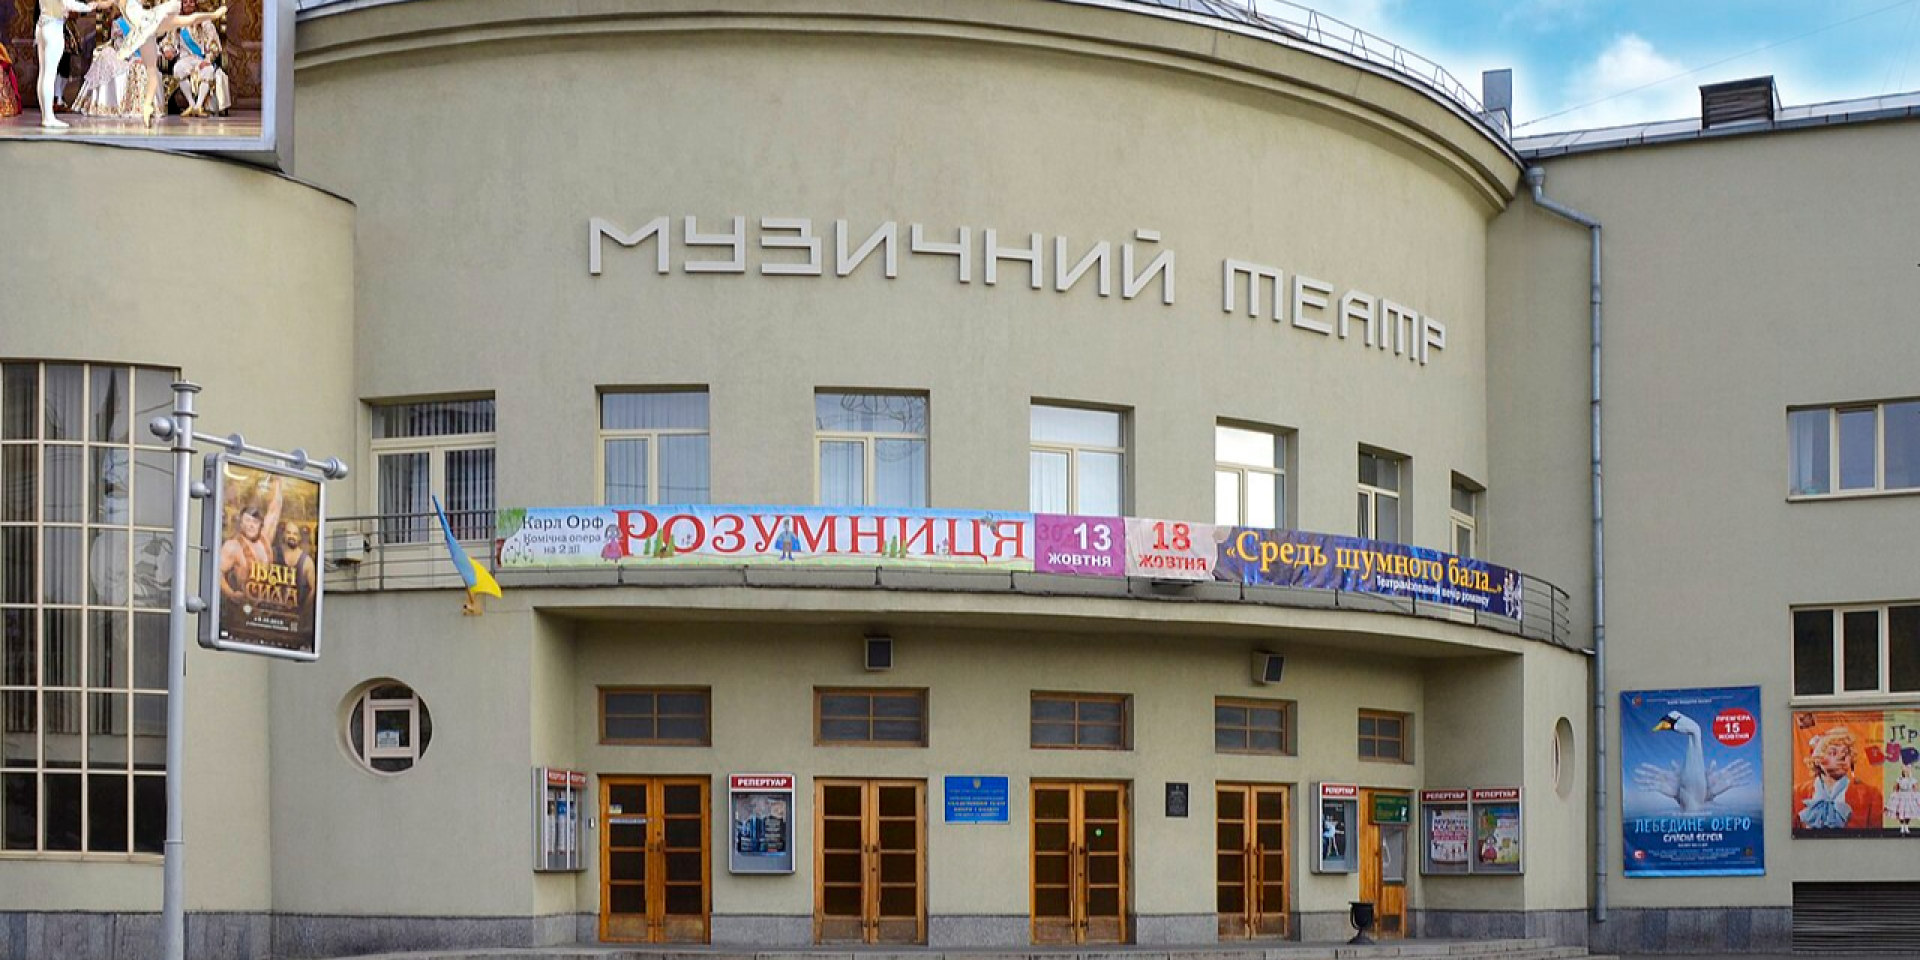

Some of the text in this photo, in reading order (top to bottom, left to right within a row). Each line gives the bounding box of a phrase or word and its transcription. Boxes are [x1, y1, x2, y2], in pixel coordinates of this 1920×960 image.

[589, 215, 1446, 366] МУЗИЧНИЙ ТЕАТР
[522, 514, 604, 531] Карл Орф
[569, 534, 601, 544] опера
[612, 509, 1026, 564] РОЗУМНИЦЯ
[1073, 522, 1112, 551] 13
[1152, 521, 1192, 552] 18
[559, 544, 566, 554] 2
[1226, 530, 1329, 574] «Средь
[1335, 547, 1444, 583] шумного
[1725, 722, 1740, 733] 15
[737, 777, 788, 787] РЕПЕРТУАР
[1426, 791, 1465, 799] РЕПЕРТУАР
[1475, 790, 1517, 799] РЕПЕРТУАР
[1634, 815, 1752, 834] ЛЕБЕДИНЕ ОЗЕРО
